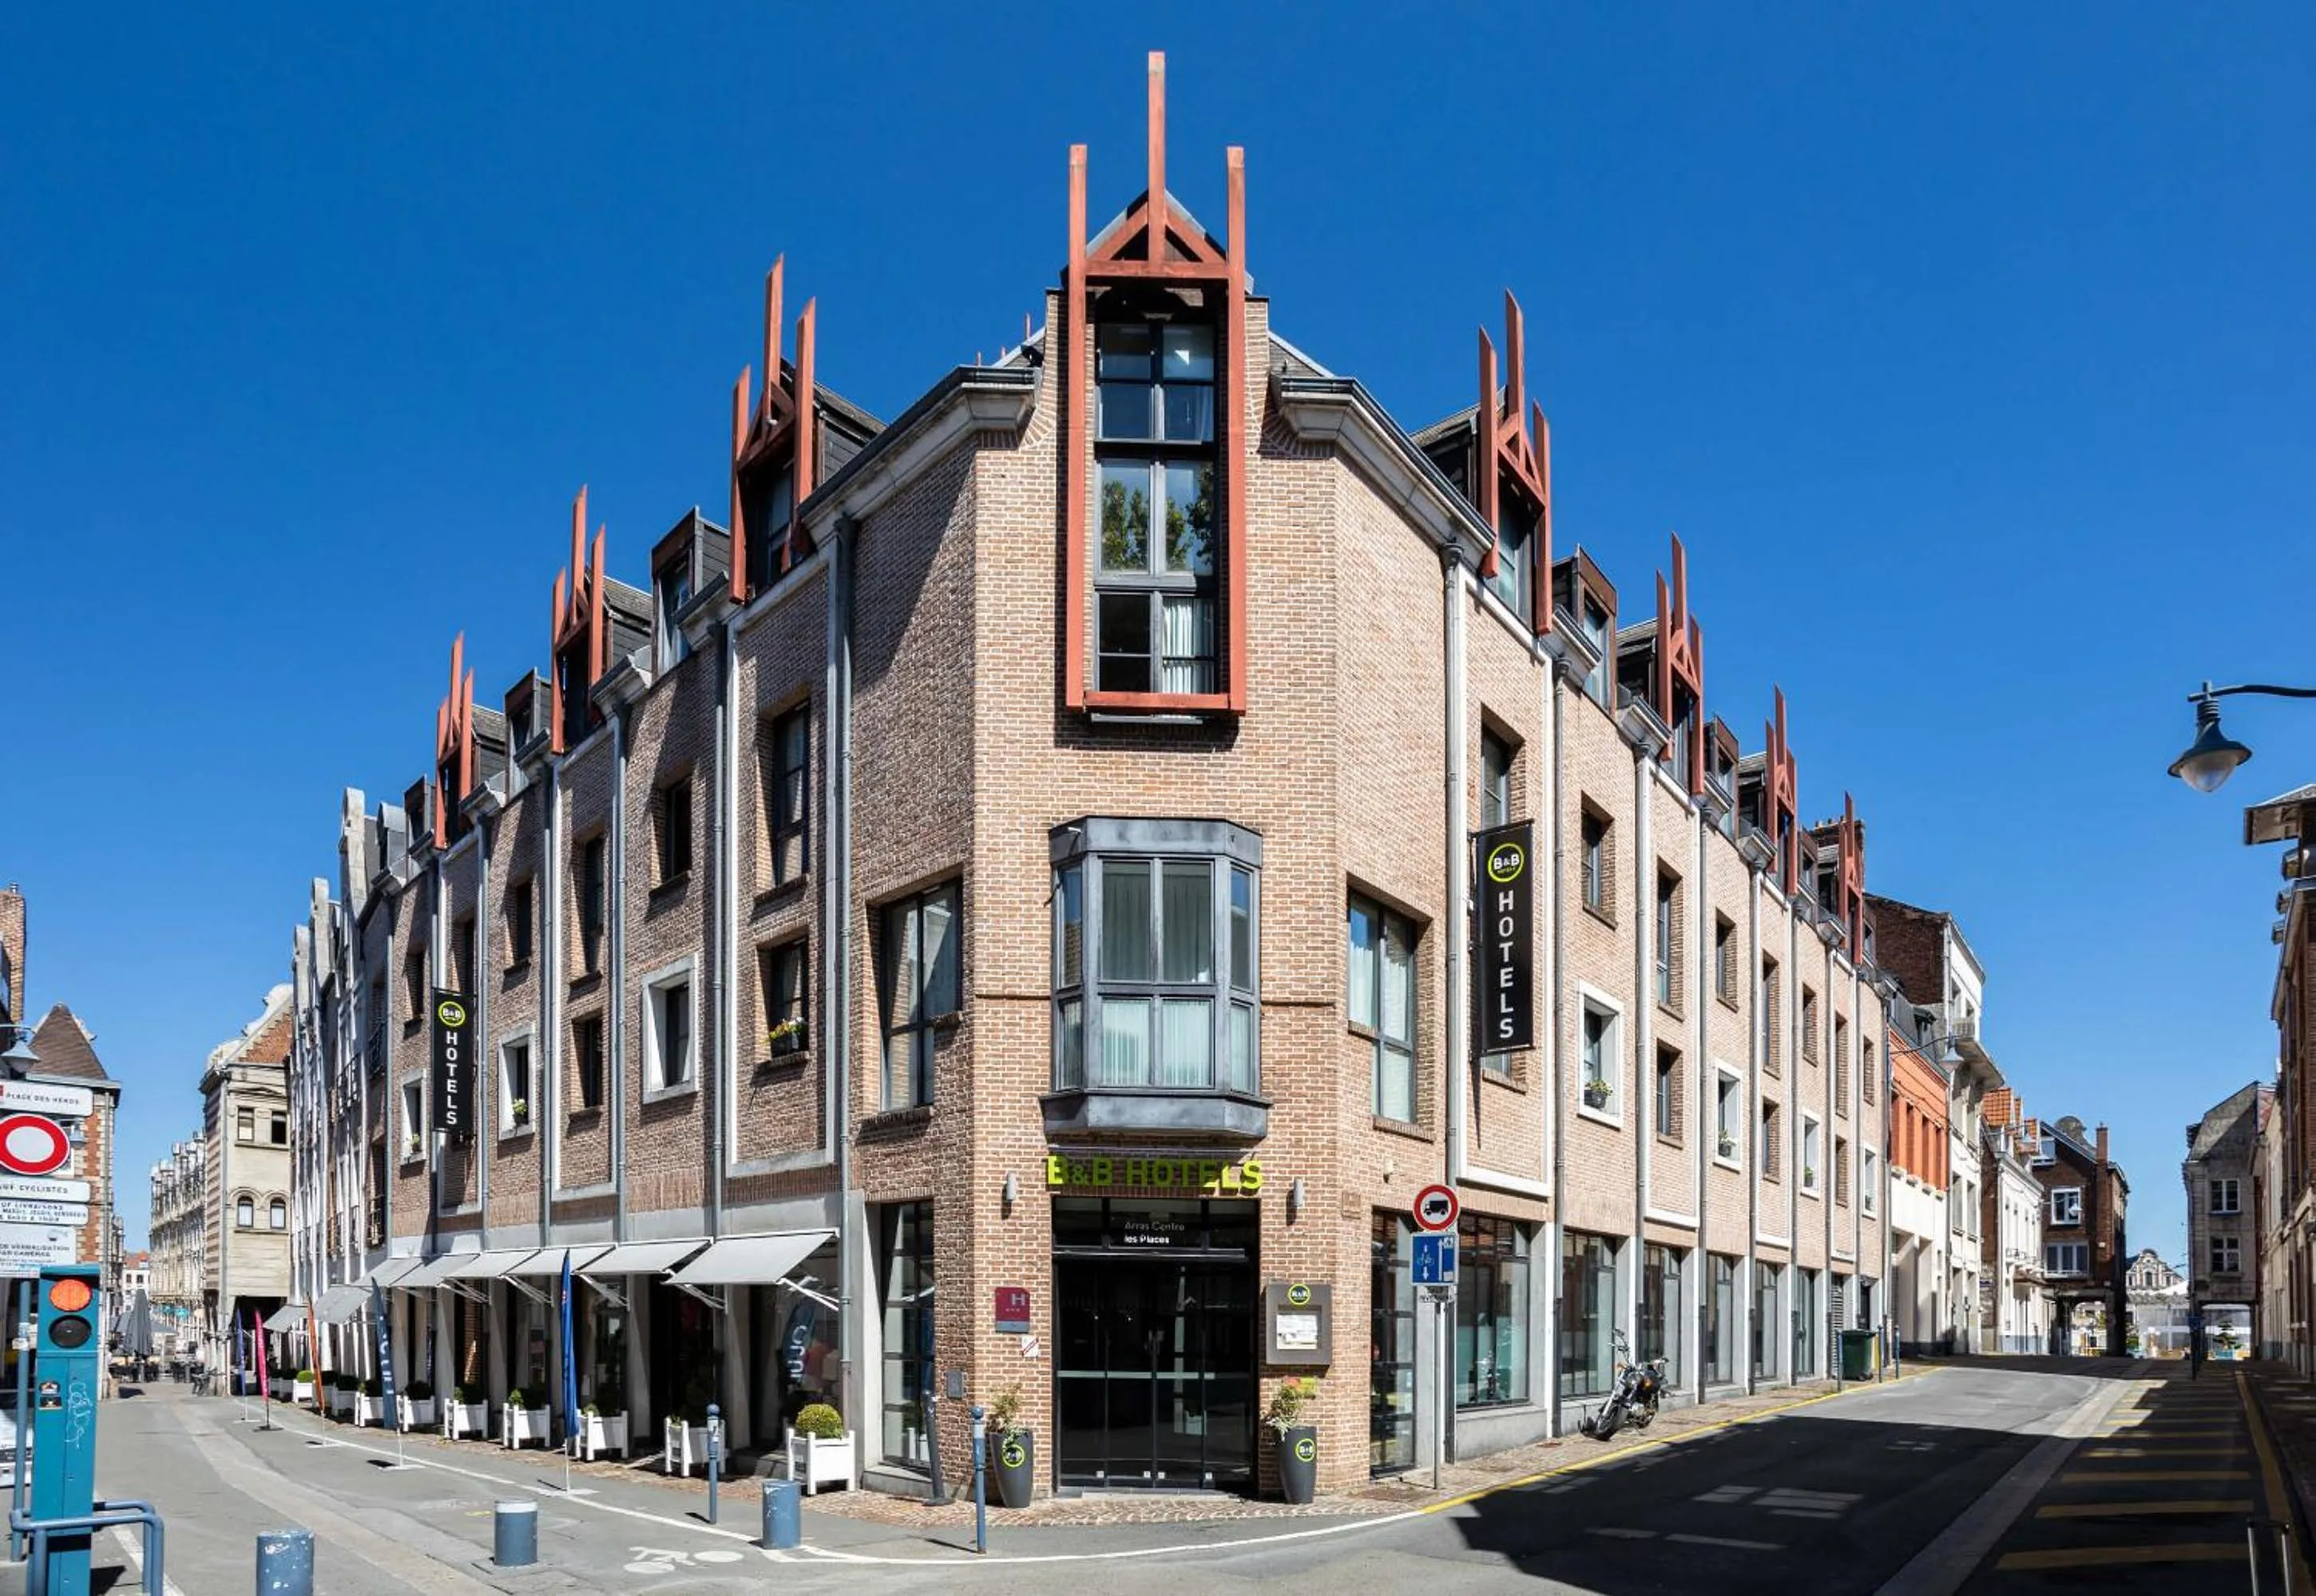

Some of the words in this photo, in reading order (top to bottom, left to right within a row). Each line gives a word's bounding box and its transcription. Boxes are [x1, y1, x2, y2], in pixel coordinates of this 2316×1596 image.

[1493, 853, 1520, 870] B&B
[1498, 889, 1514, 1039] HOTELS
[446, 1031, 458, 1125] HOTELS
[1048, 1155, 1112, 1186] B&B
[1126, 1158, 1263, 1189] HOTELS
[19, 1185, 69, 1194] CYCLISTES
[1124, 1221, 1149, 1230] Arras
[1152, 1221, 1185, 1231] Centre
[1140, 1234, 1169, 1243] Places
[1011, 1293, 1025, 1306] H
